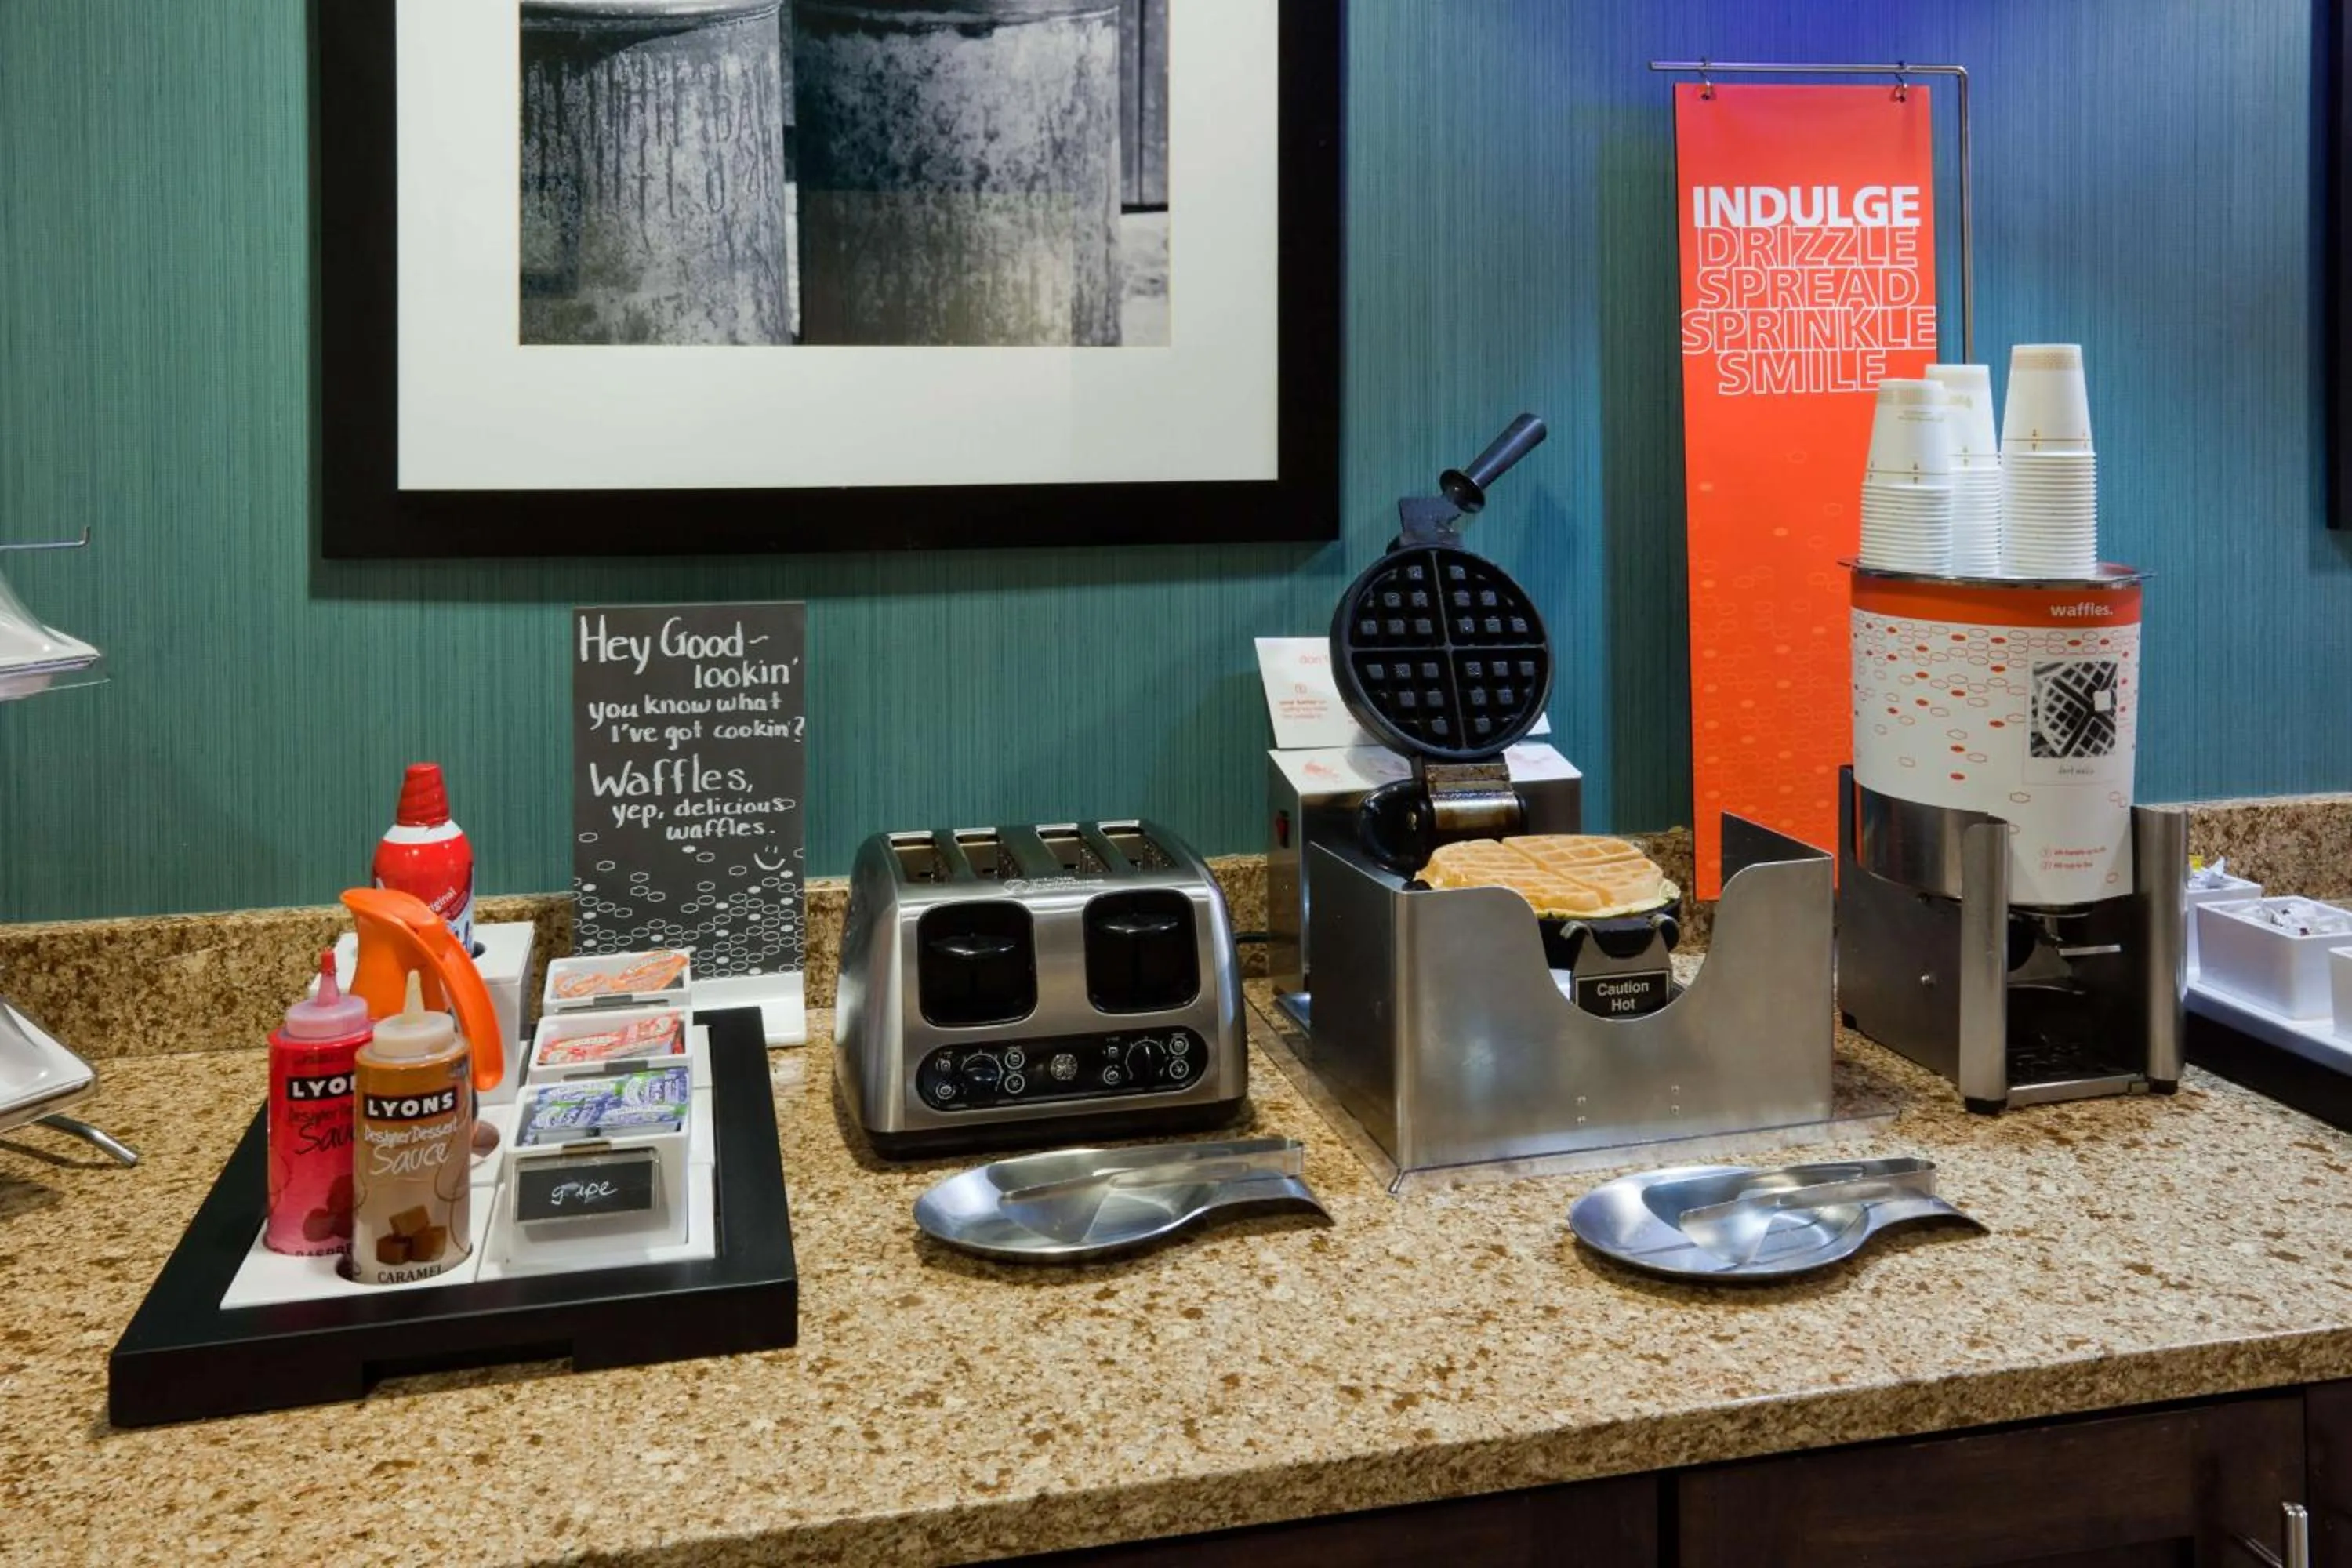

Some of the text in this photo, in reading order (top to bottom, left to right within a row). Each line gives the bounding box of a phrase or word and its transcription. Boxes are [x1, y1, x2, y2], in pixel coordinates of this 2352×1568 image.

[1693, 186, 1921, 227] INDULGE
[1697, 225, 1918, 268] DRIZZLE
[1697, 266, 1920, 310] SPREAD
[1681, 305, 1937, 354] SPRINKLE
[1717, 348, 1886, 395] SMILE
[2050, 601, 2114, 618] waffles.
[580, 614, 652, 675] Hey
[589, 691, 782, 730] you know what
[612, 723, 658, 742] I've
[665, 720, 702, 751] got
[590, 753, 753, 797] Waffles,
[674, 797, 786, 817] delicious
[666, 817, 775, 840] waffles.
[1597, 980, 1649, 996] Caution
[1611, 998, 1635, 1012] Hot
[292, 1075, 357, 1098] LYO
[368, 1091, 454, 1117] LYONS
[369, 1142, 449, 1174] Sauce
[377, 1264, 443, 1284] CARAMEL
